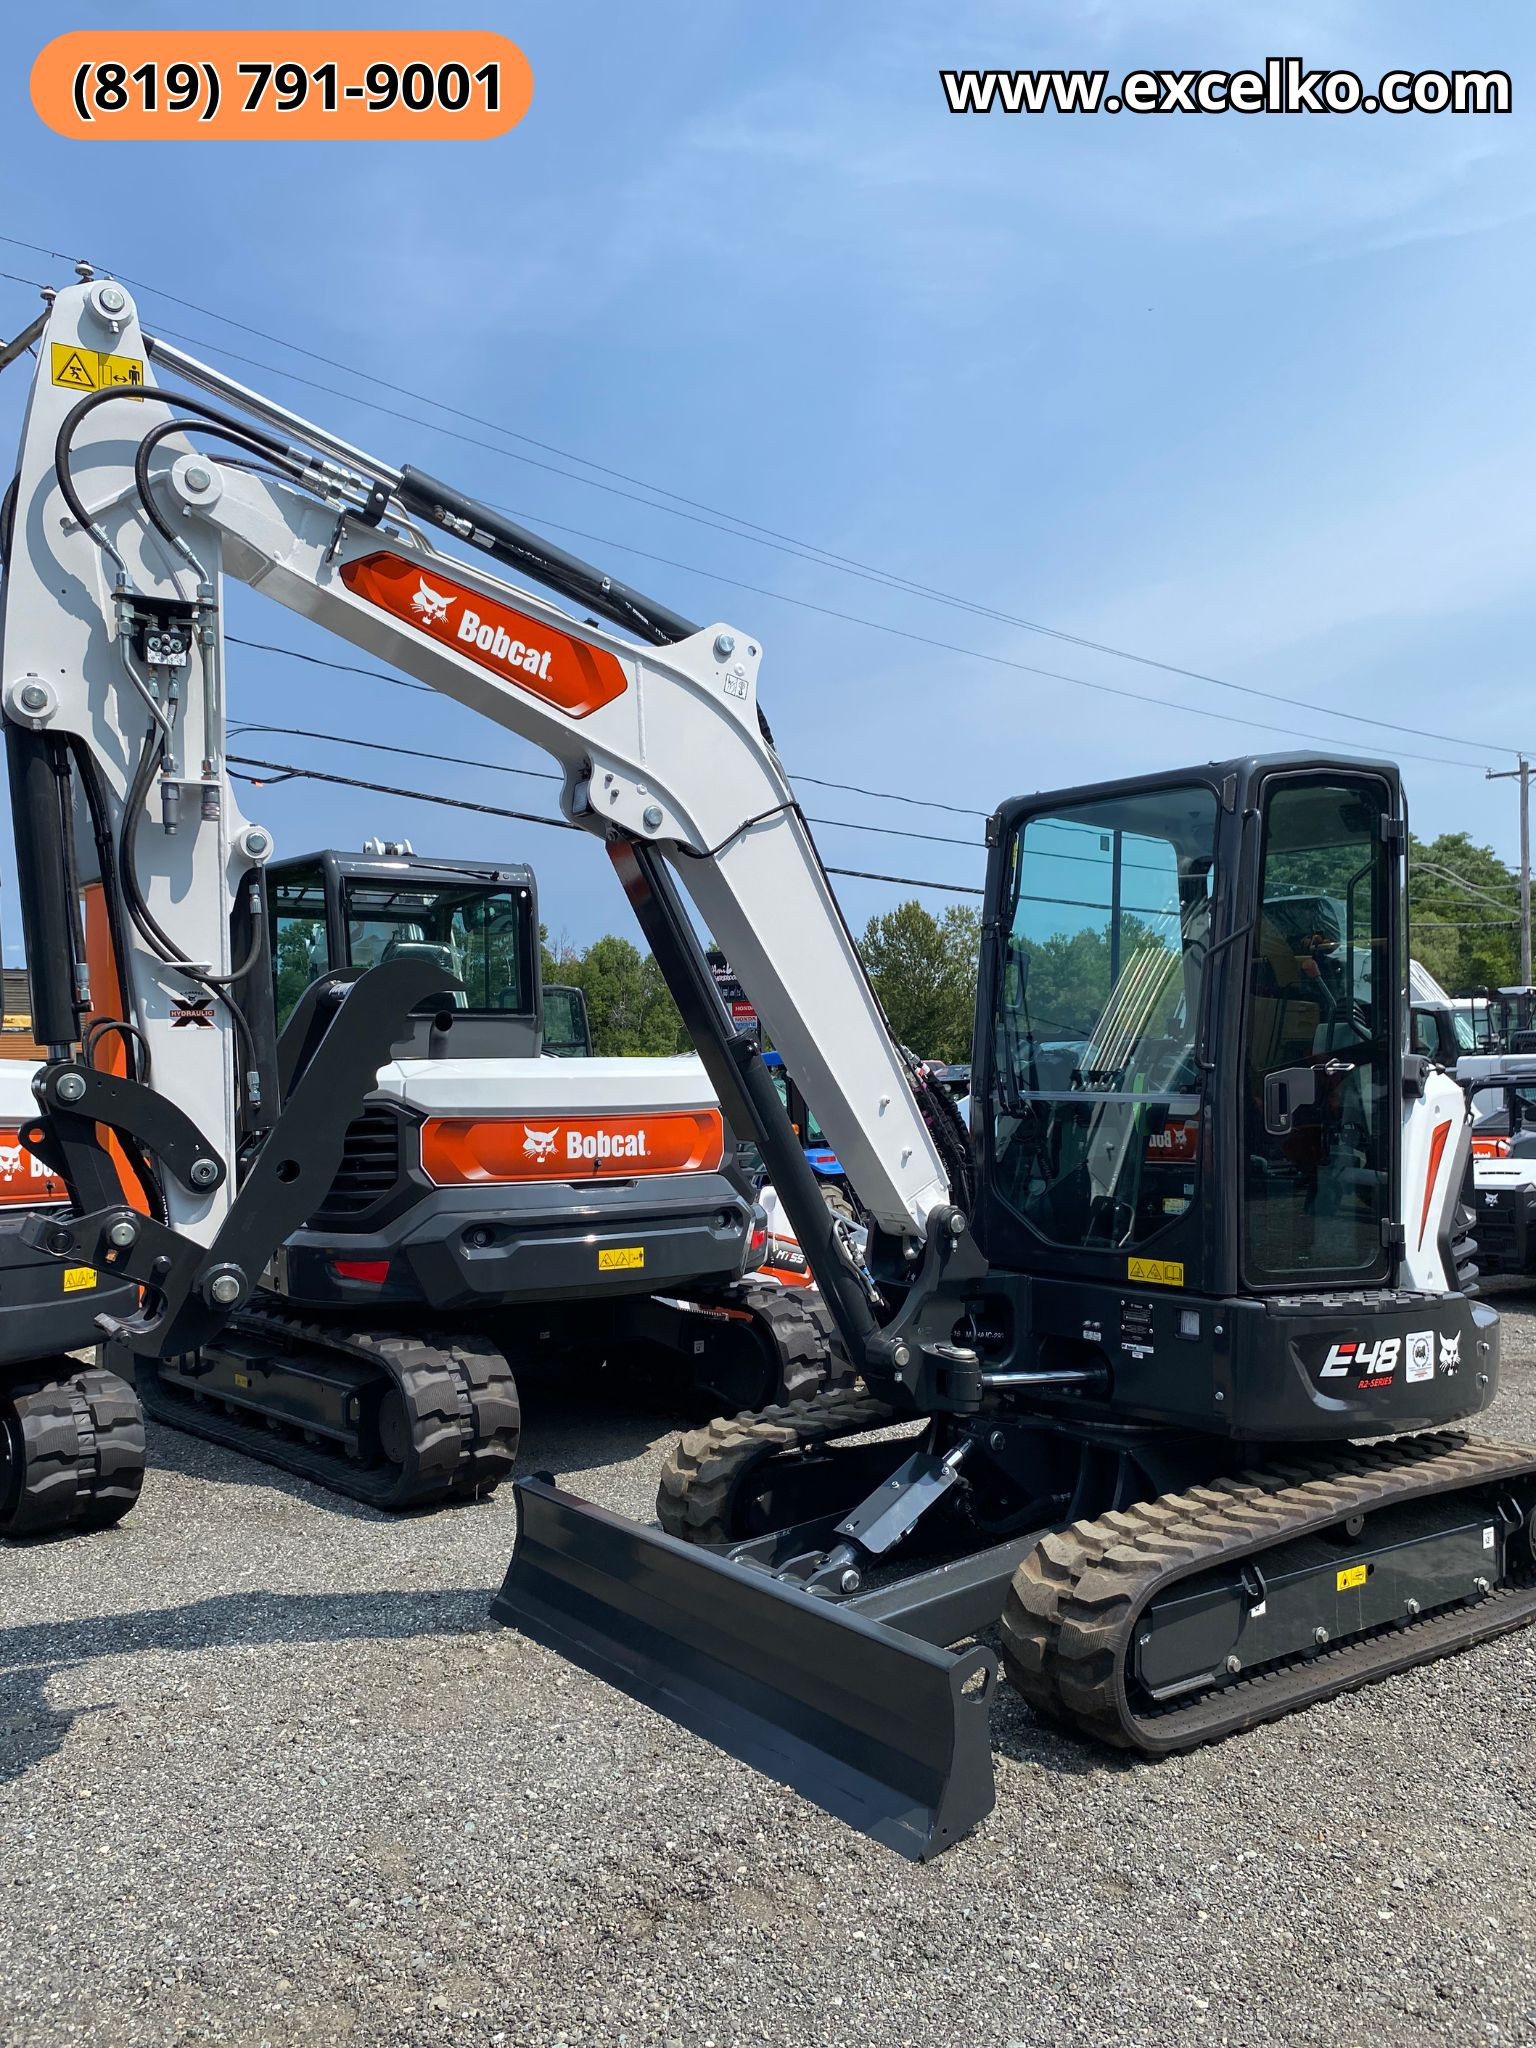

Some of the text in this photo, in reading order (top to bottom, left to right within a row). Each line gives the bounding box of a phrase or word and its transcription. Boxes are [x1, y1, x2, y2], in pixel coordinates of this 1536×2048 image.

[457, 609, 552, 681] Bobcat
[566, 1130, 651, 1159] Bobcat
[776, 1250, 805, 1264] MT55
[1319, 1337, 1401, 1377] E48
